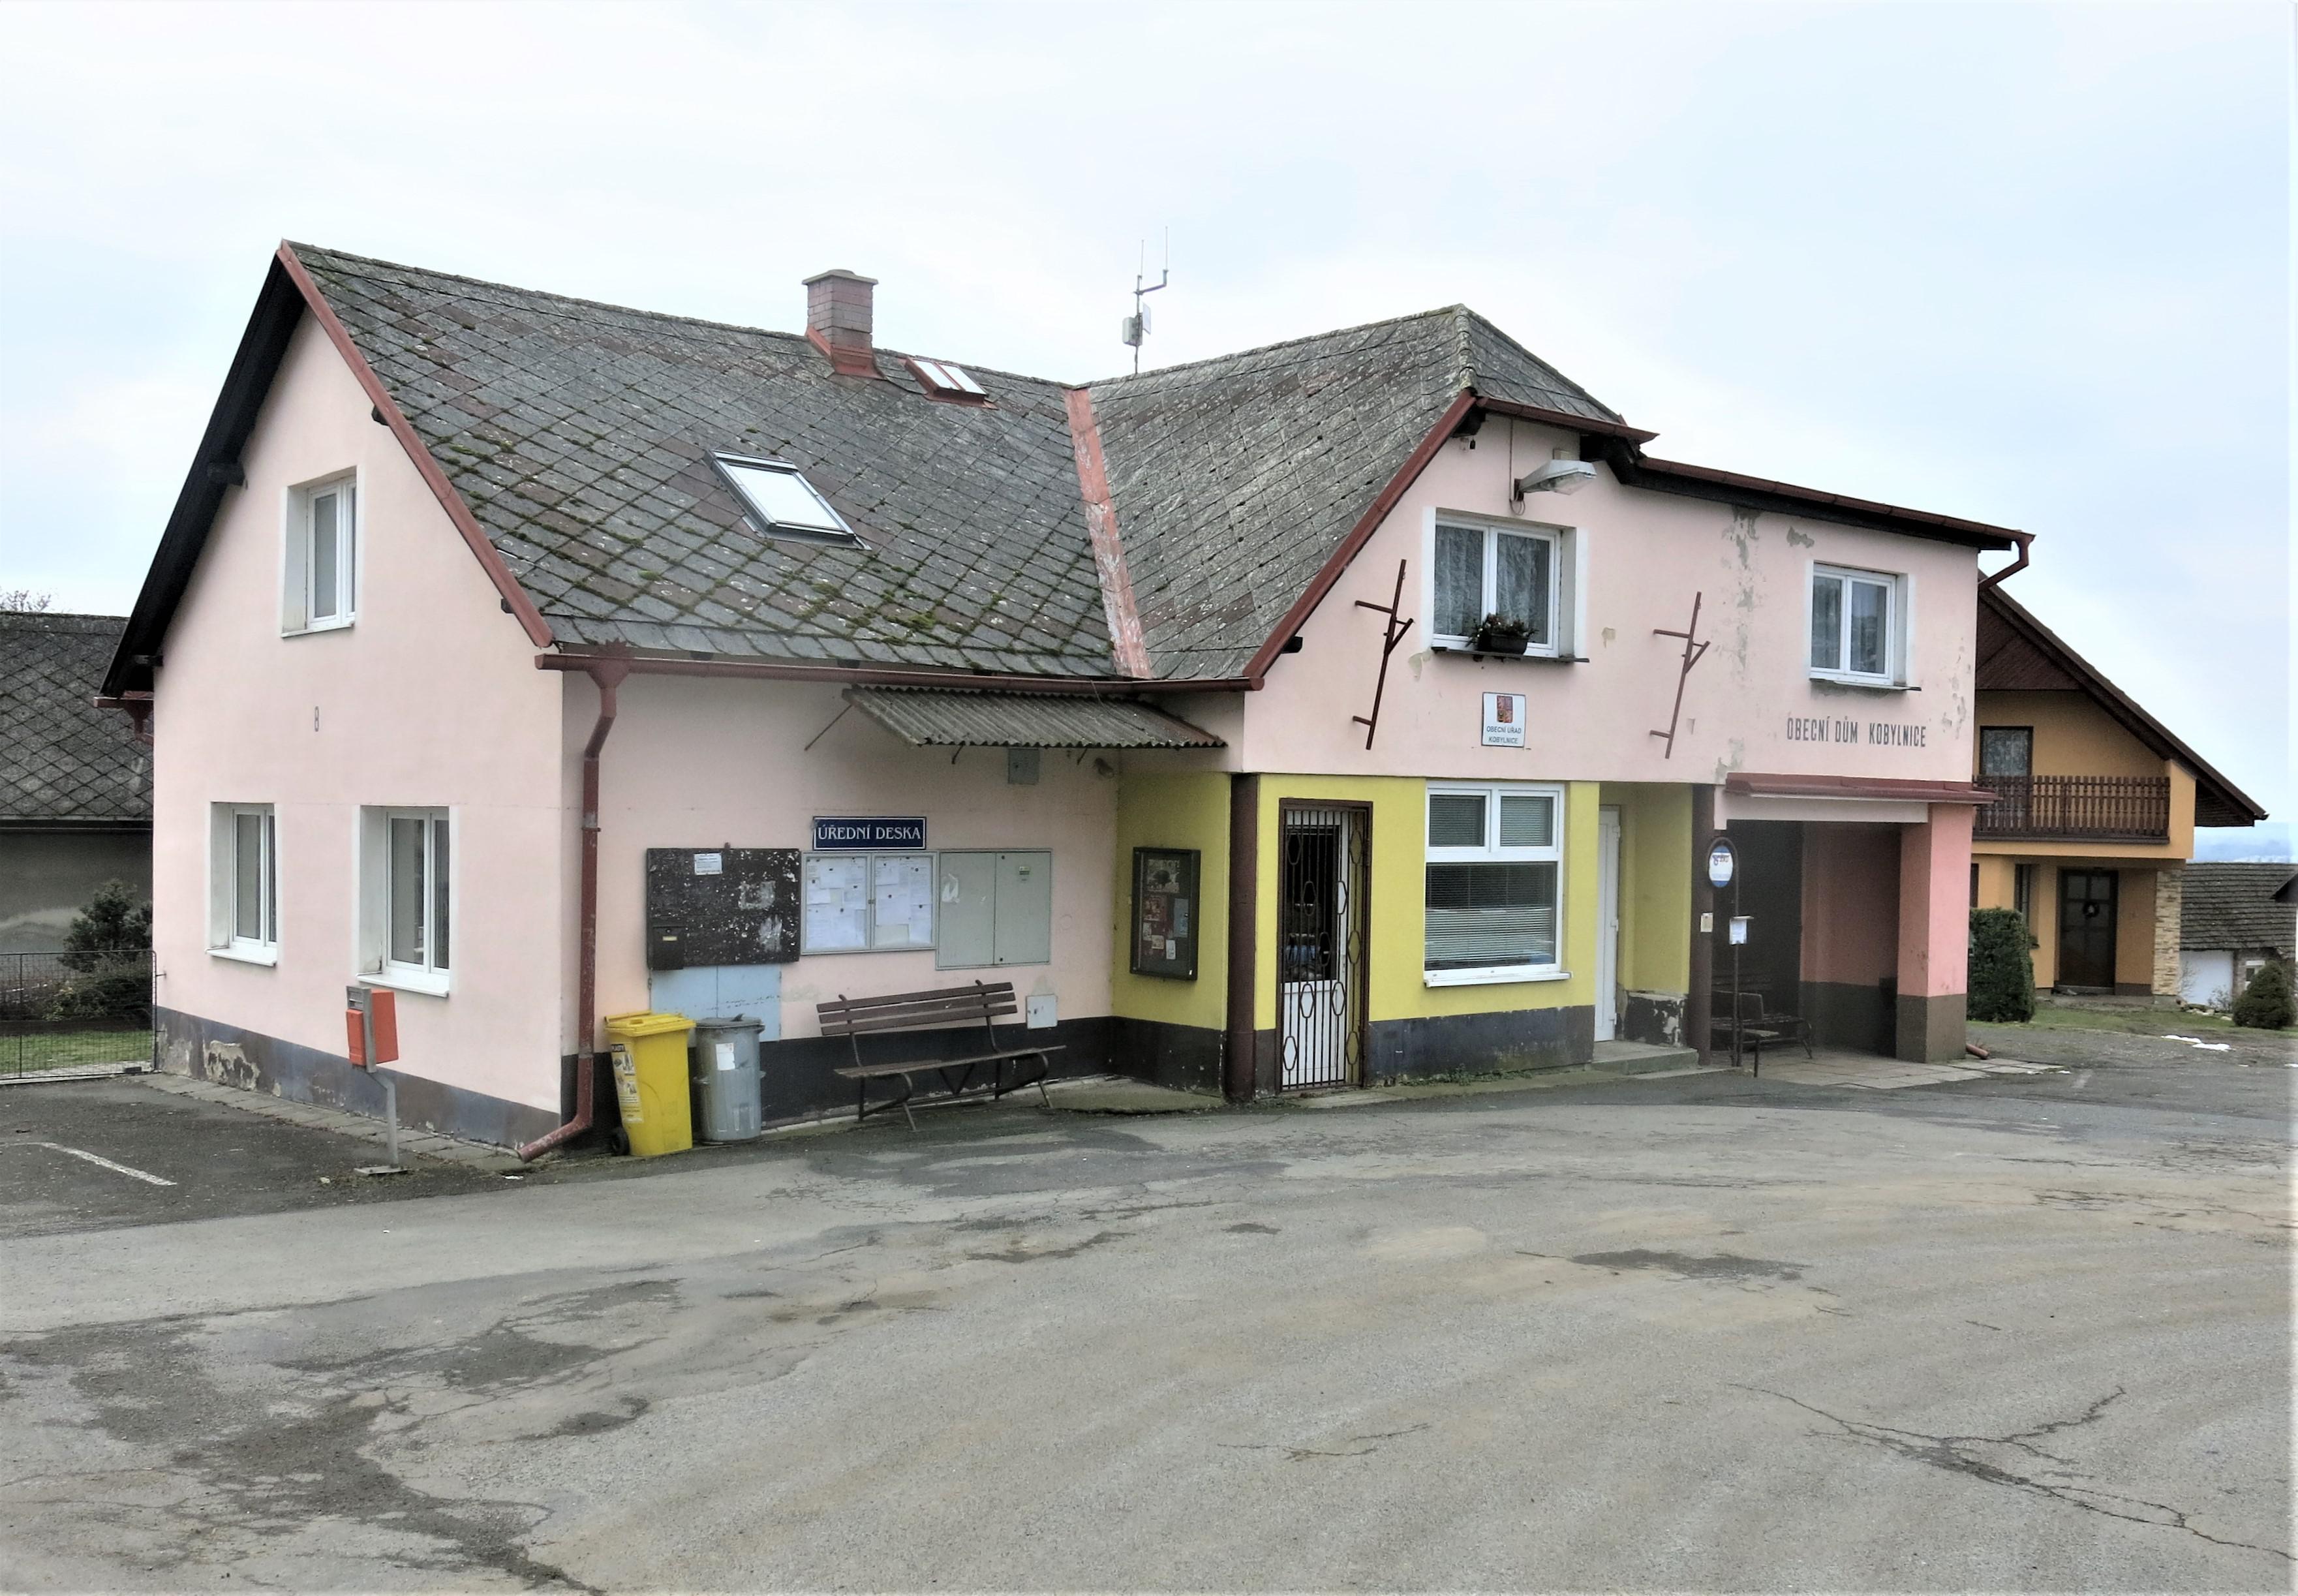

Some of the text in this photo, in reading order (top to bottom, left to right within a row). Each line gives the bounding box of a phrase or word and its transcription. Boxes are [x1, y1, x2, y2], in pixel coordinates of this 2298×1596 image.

[1786, 716, 1926, 748] OBECNÍ DŮM KOBYLNICE
[818, 824, 921, 840] ÚŘEDNÍ DESKA
